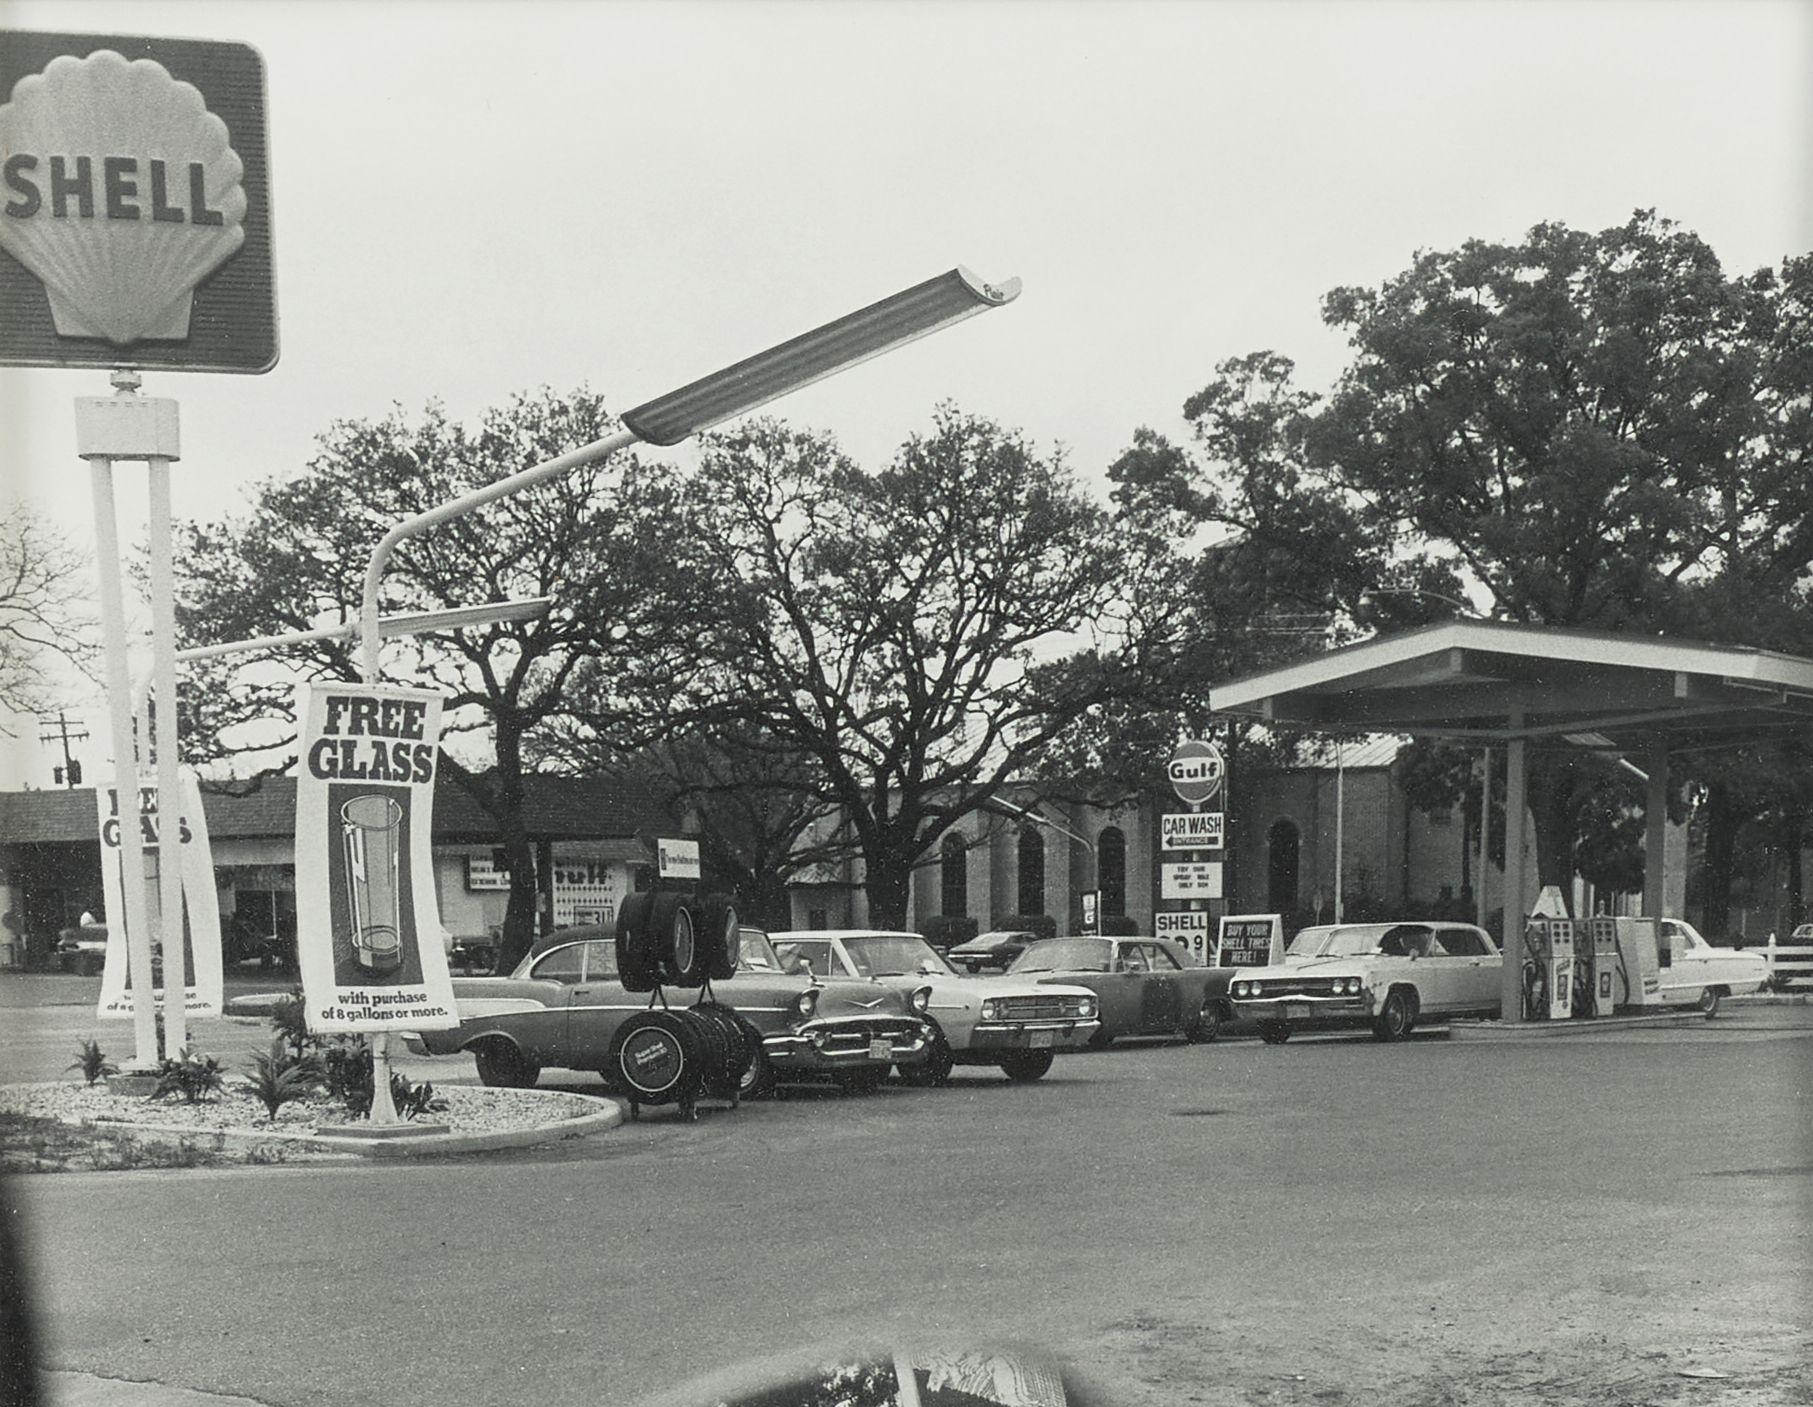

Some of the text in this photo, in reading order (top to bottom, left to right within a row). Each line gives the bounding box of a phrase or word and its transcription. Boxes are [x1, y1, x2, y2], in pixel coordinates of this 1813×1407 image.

[2, 153, 224, 226] SHELL
[323, 695, 427, 740] FREE
[308, 738, 433, 784] GLASS
[1170, 763, 1217, 779] Gulf
[1163, 816, 1222, 835] CAR WASH
[1157, 915, 1206, 930] SHELL
[1227, 924, 1268, 937] BUY YOUR
[1221, 938, 1245, 950] SHELL
[1231, 950, 1257, 963] HERE!
[338, 991, 428, 1007] with purchase
[321, 1007, 448, 1022] of 8 gallons or more.
